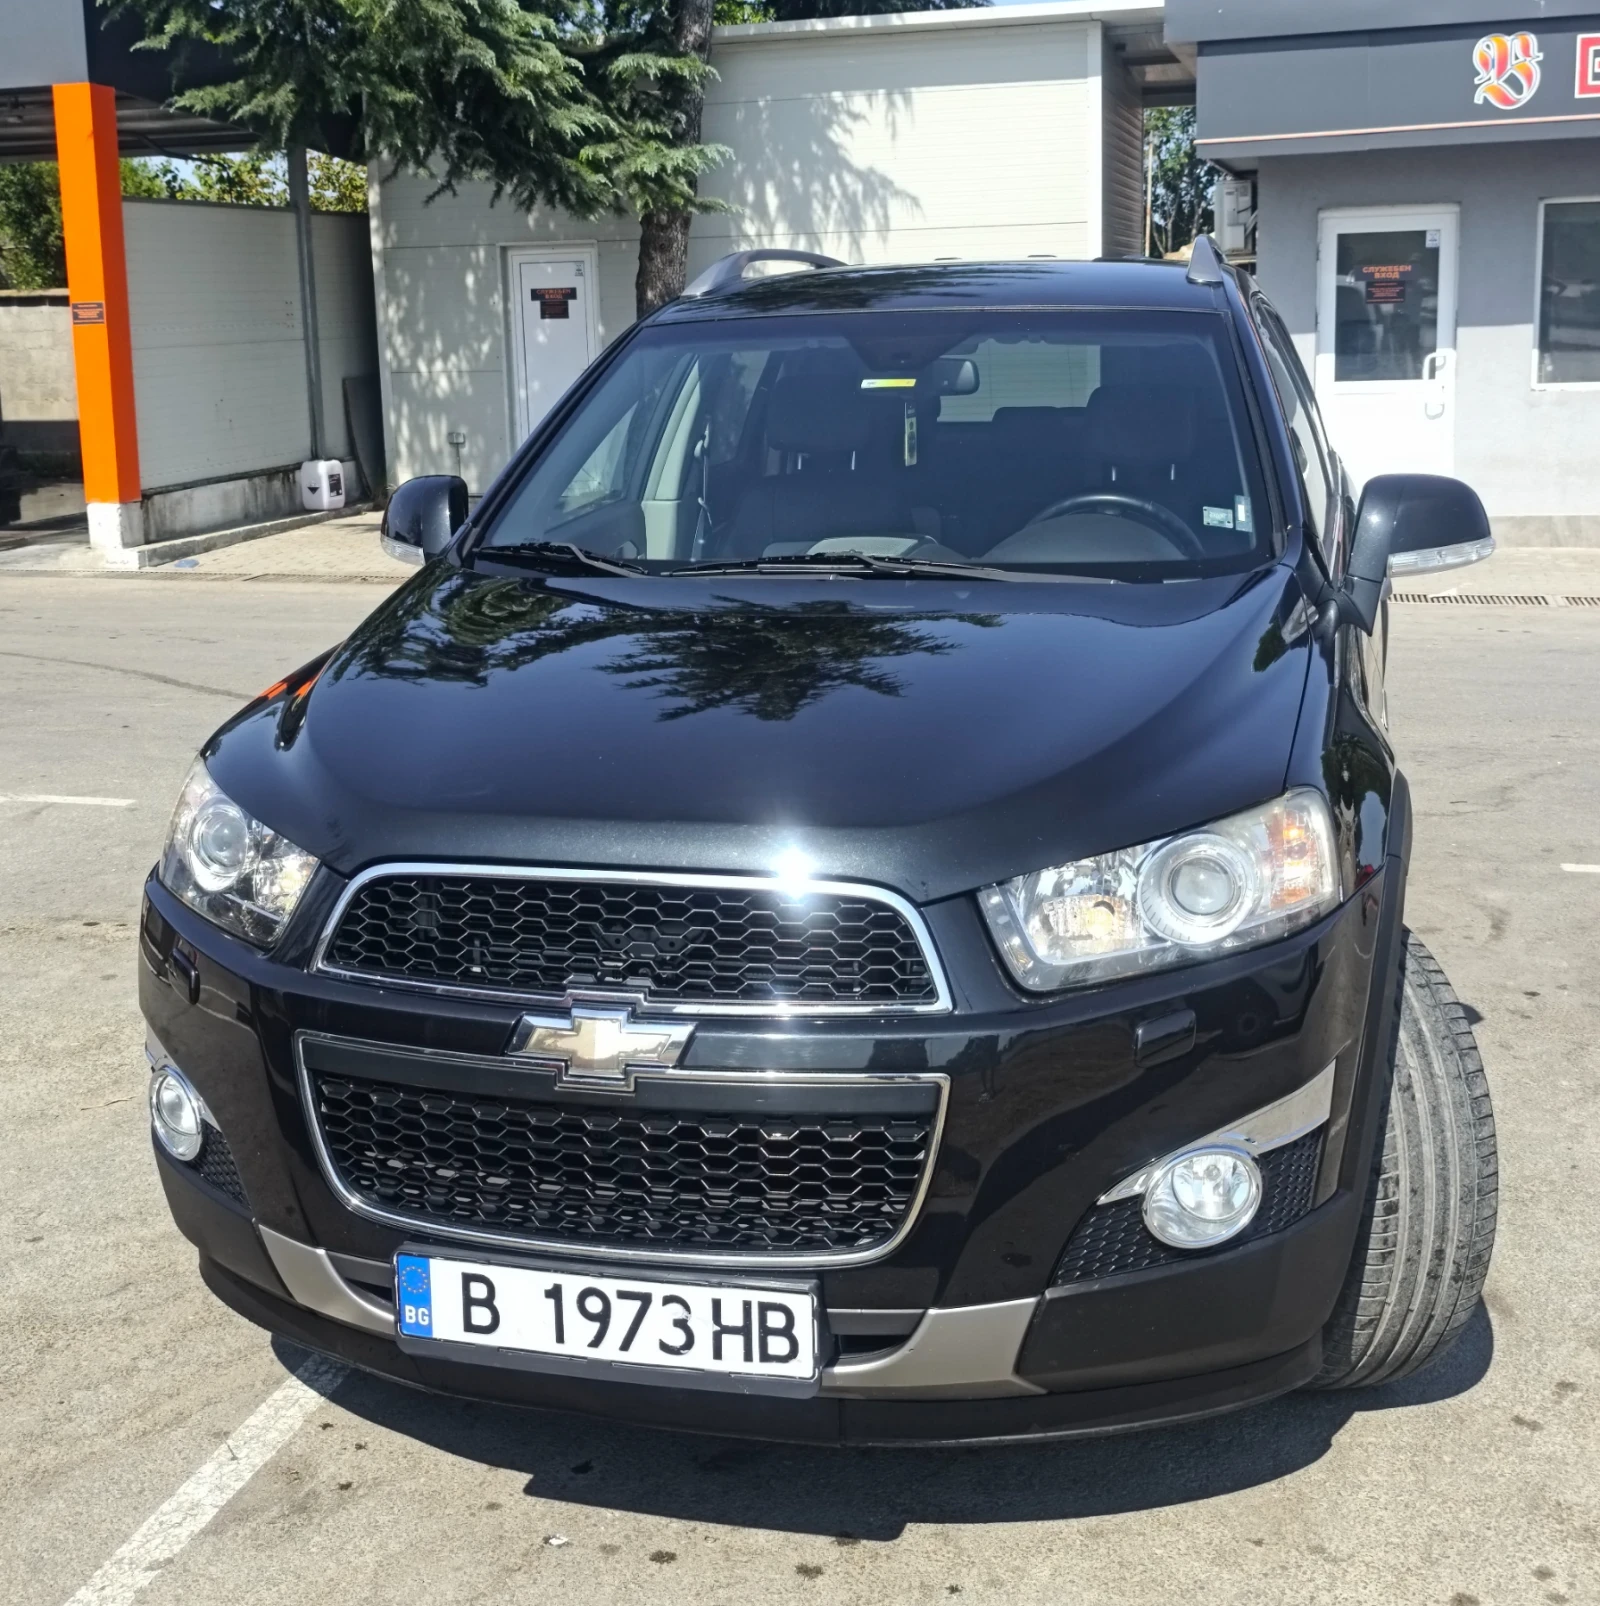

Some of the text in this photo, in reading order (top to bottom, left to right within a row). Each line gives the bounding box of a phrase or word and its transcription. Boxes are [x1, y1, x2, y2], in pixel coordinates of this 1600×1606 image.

[1362, 264, 1412, 273] СЛУЖЕБЕН
[405, 1305, 429, 1325] BG
[461, 1272, 800, 1364] B 1973 HB
